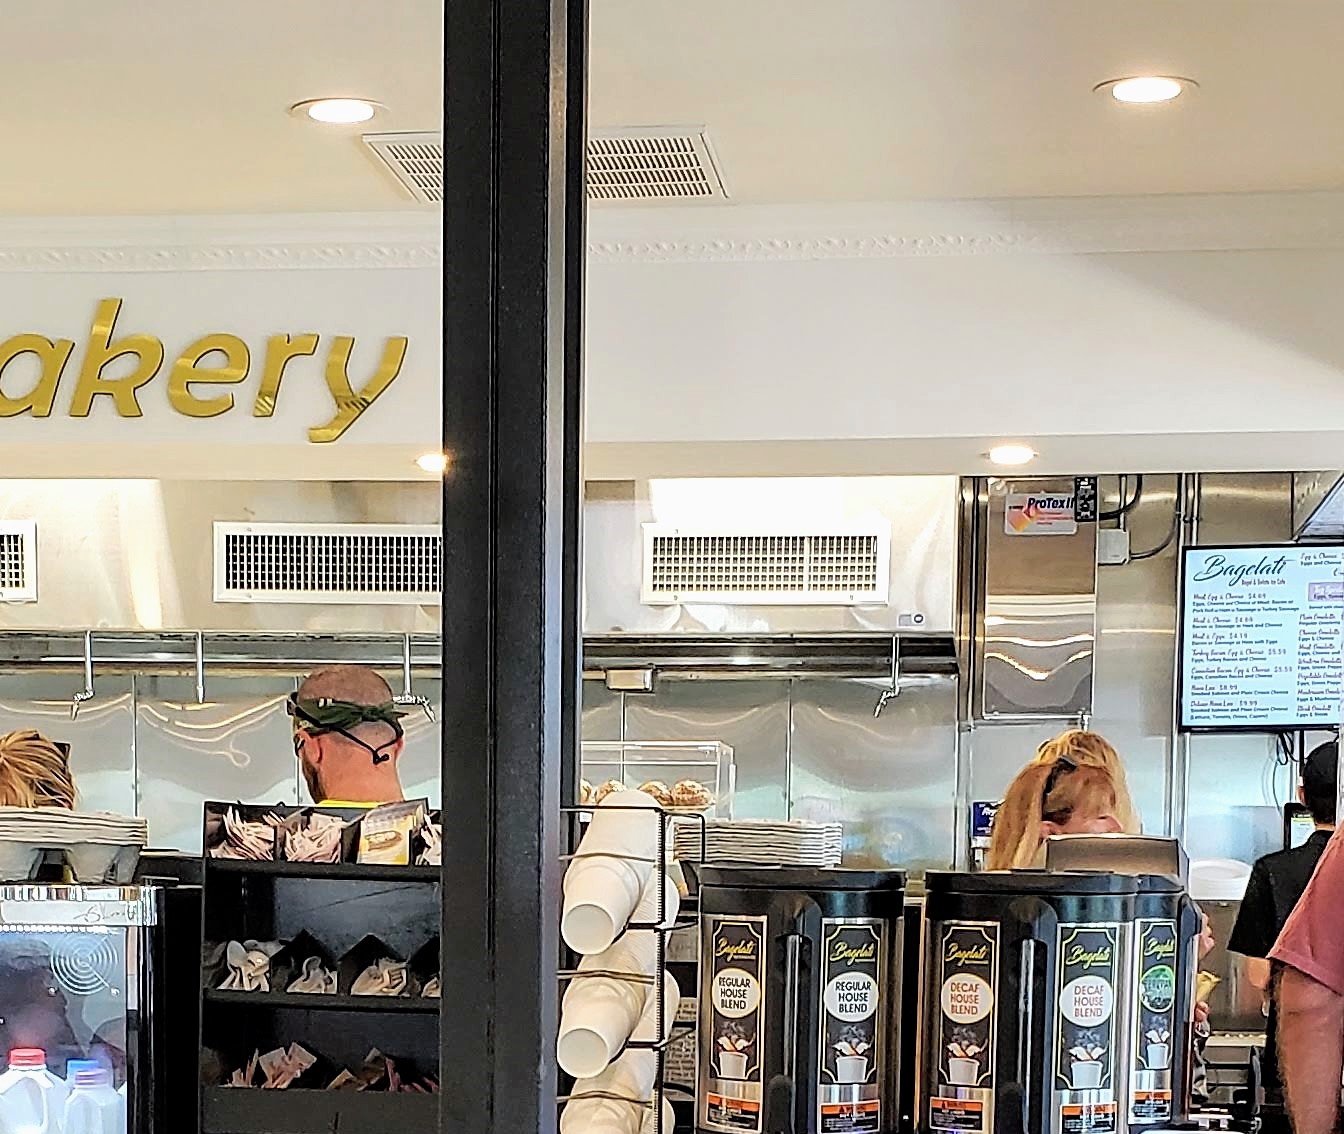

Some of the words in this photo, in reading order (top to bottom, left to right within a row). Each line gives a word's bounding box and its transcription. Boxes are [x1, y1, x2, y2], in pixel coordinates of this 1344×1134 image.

[1193, 555, 1292, 587] Bagelati
[718, 976, 751, 989] REGULAR
[835, 981, 872, 992] REGULAR
[950, 982, 981, 993] DECAF
[720, 988, 747, 999] HOUSE
[1074, 985, 1105, 996] DECAF
[838, 992, 868, 1003] HOUSE
[950, 993, 980, 1004] HOUSE
[1074, 996, 1104, 1007] HOUSE
[721, 999, 747, 1010] BLEND
[838, 1003, 868, 1014] BLEND
[950, 1004, 979, 1015] BLEND
[1074, 1007, 1103, 1018] BLEND
